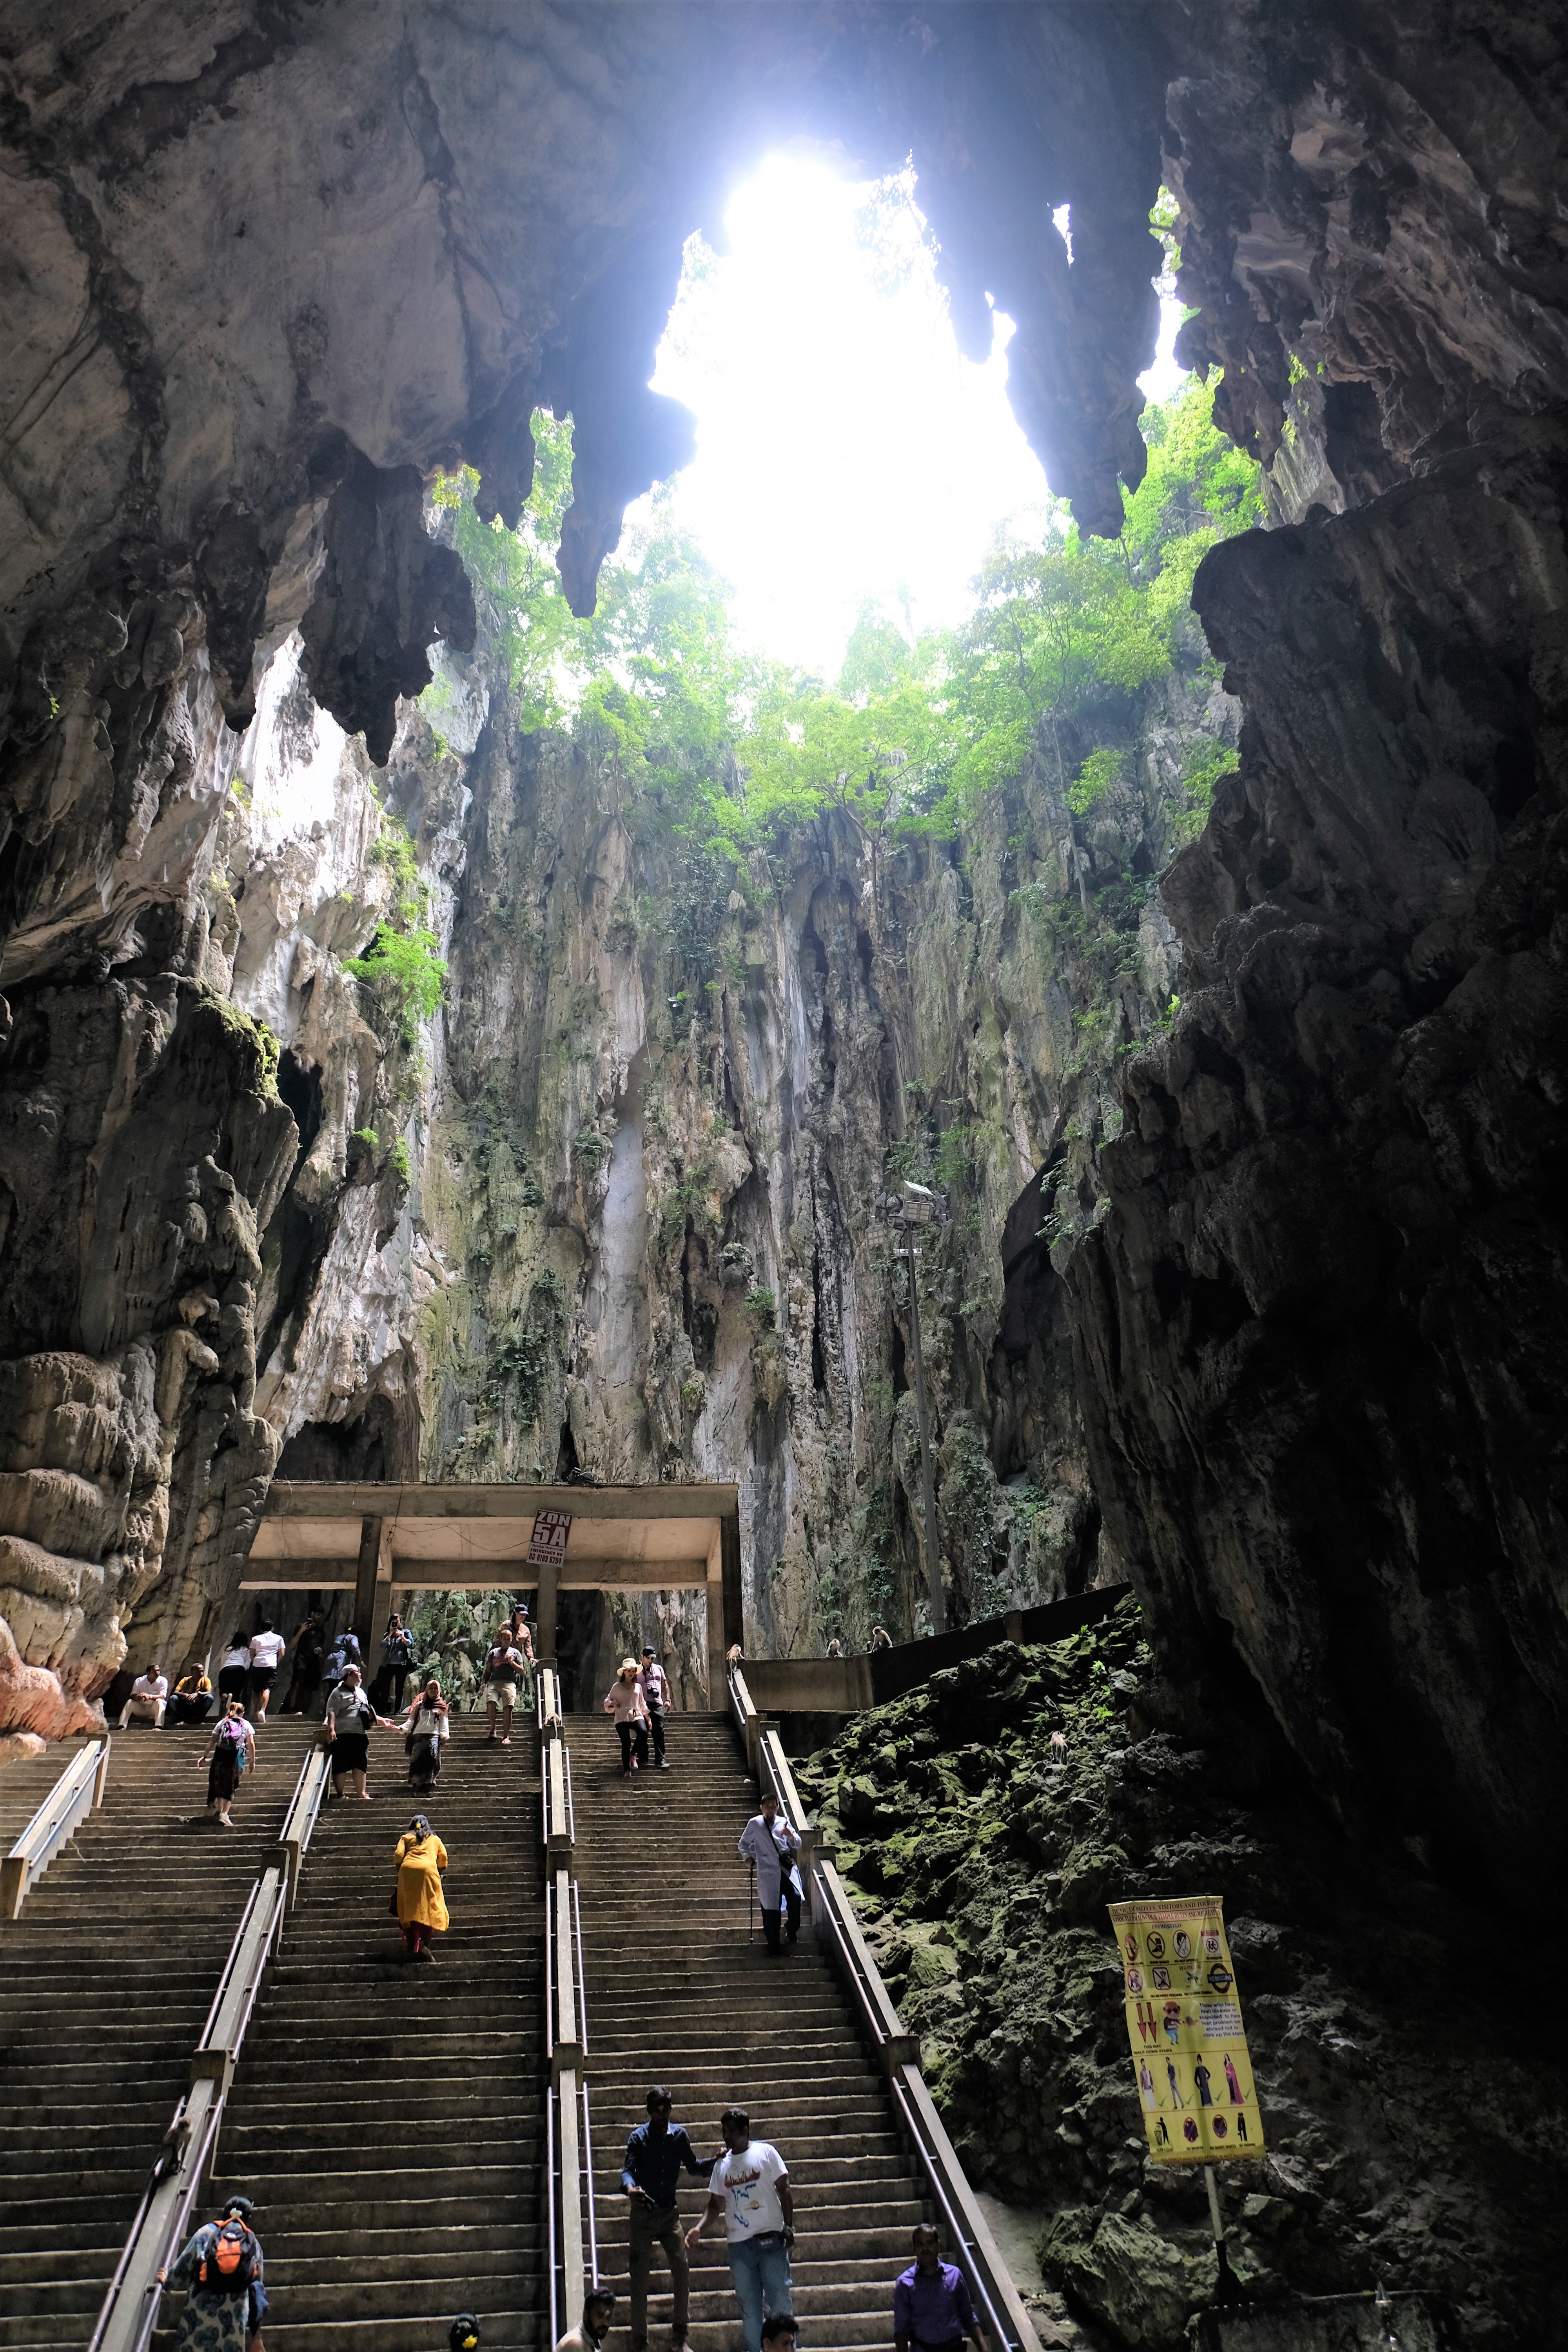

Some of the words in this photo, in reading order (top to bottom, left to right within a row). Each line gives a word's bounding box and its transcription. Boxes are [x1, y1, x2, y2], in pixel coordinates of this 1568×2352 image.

[537, 1511, 570, 1526] ZON
[533, 1523, 565, 1547] 5A
[549, 1556, 562, 1564] 6284
